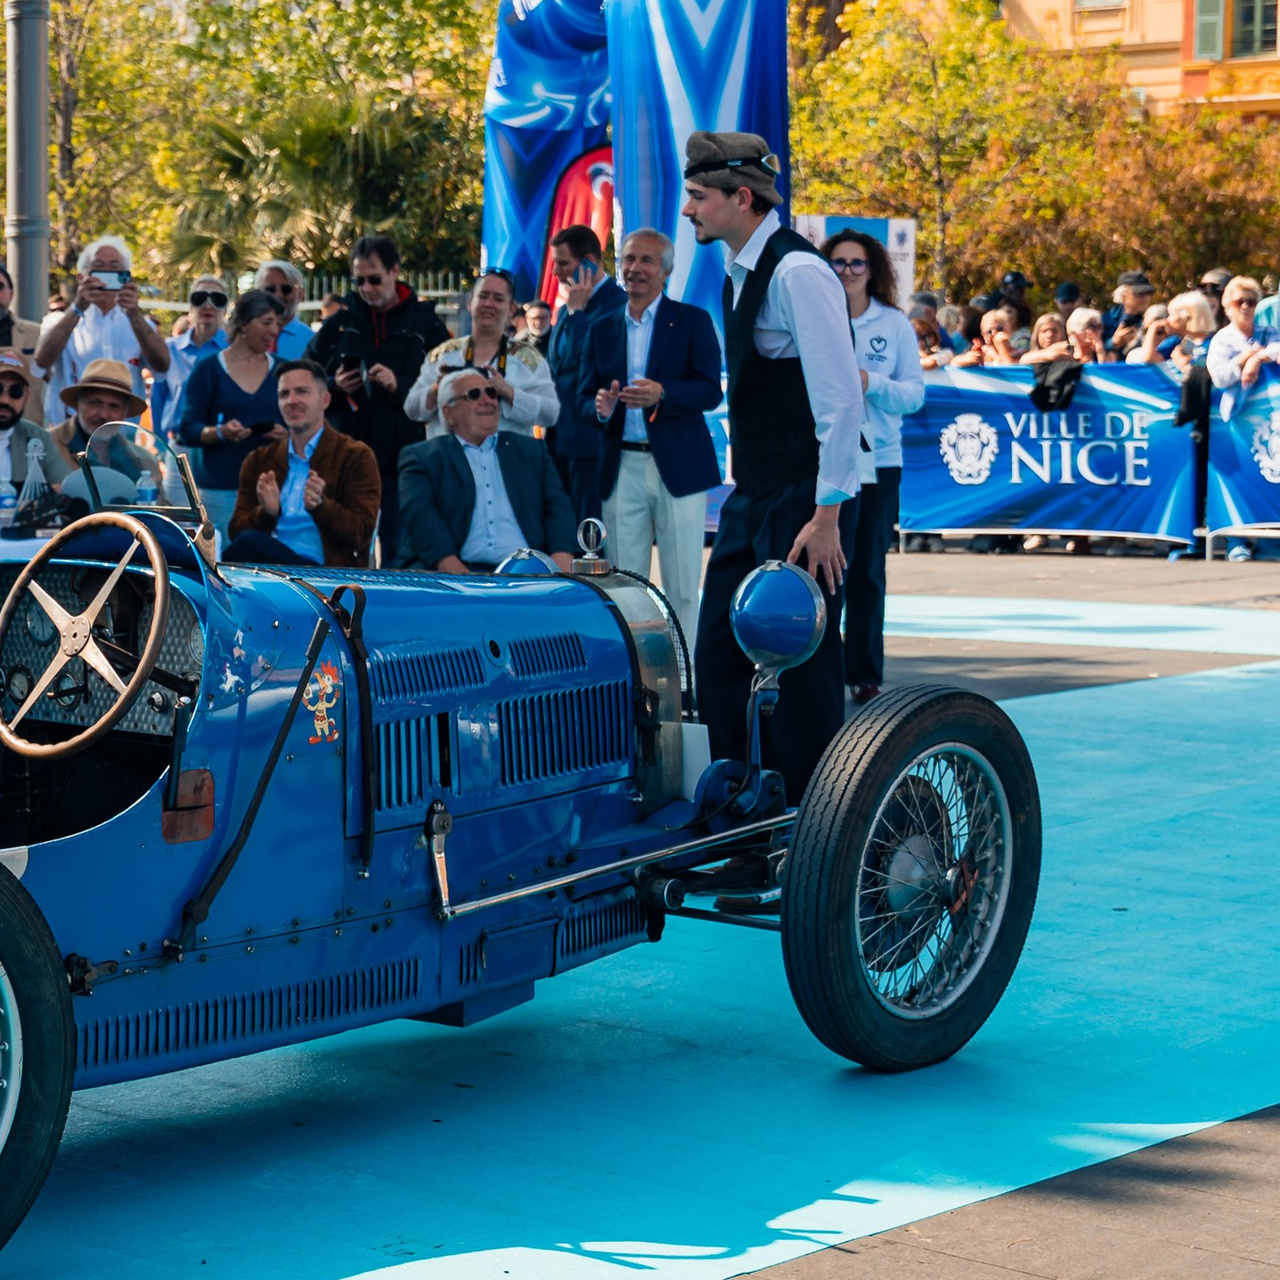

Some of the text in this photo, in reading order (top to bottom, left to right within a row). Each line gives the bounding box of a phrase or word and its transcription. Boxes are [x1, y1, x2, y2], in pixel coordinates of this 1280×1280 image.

[1003, 412, 1150, 438] VILLE DE
[1008, 440, 1151, 486] NICE
